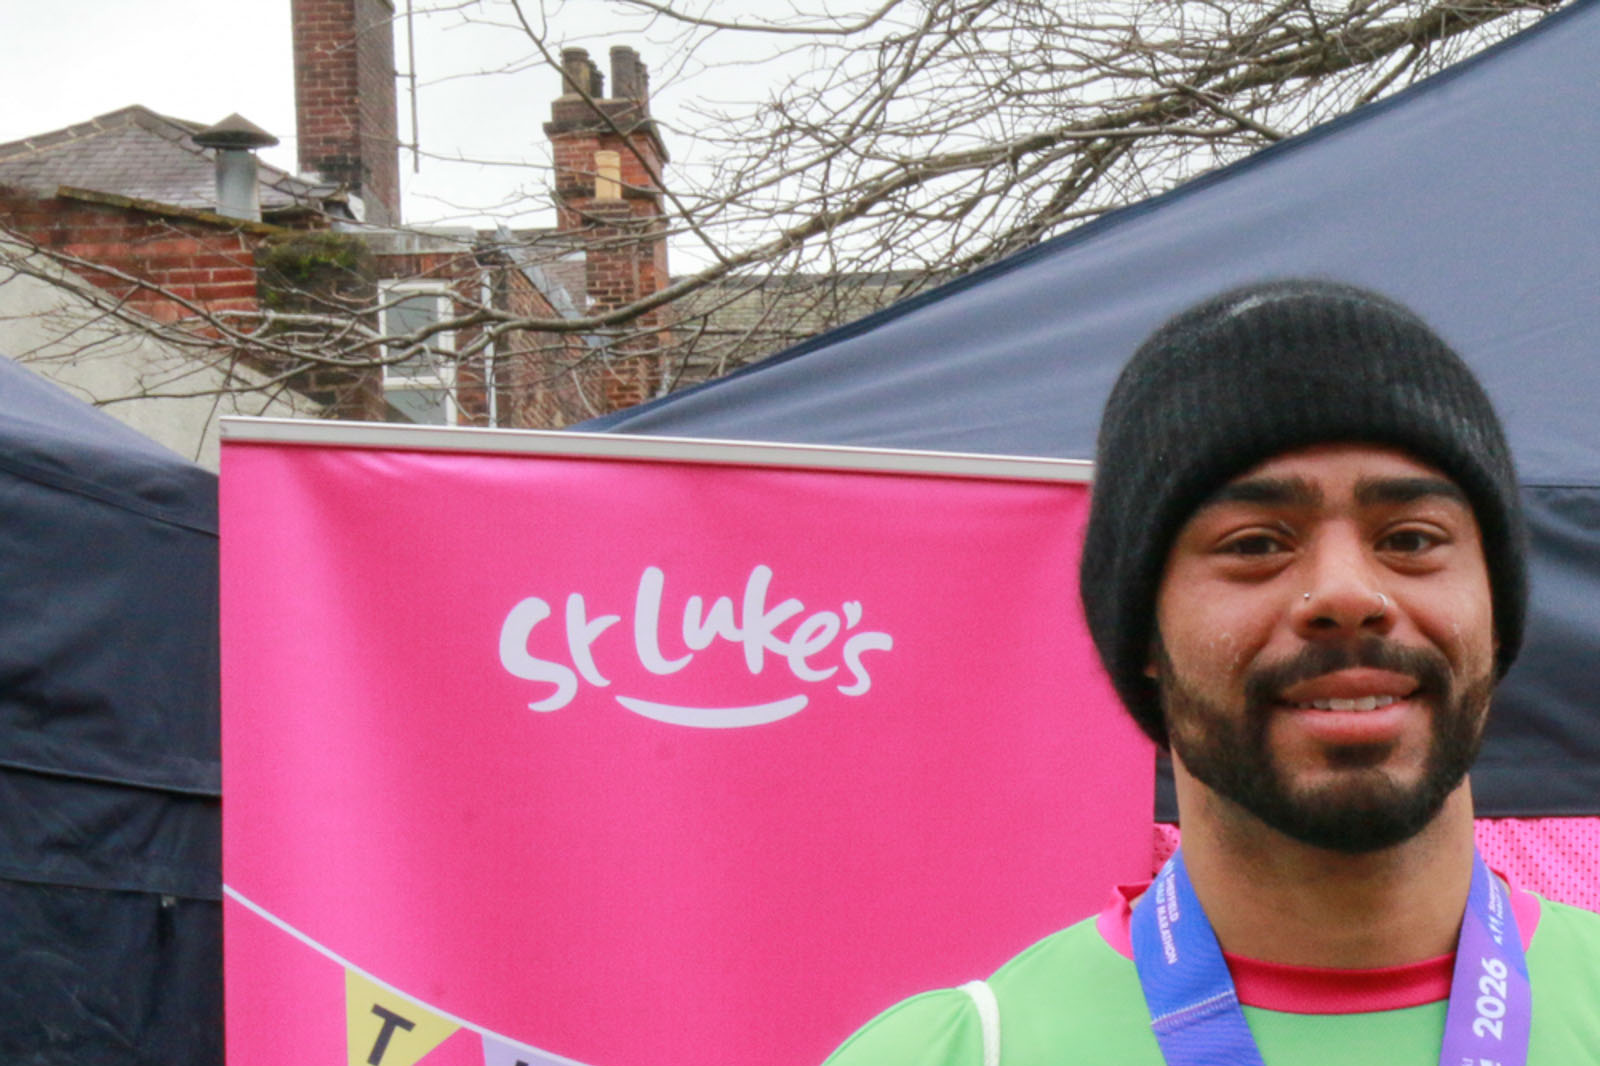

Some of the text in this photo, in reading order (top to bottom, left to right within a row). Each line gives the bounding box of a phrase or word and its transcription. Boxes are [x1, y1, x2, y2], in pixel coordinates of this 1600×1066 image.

[499, 564, 892, 712] St Luke's
[1472, 957, 1508, 1040] 2026
